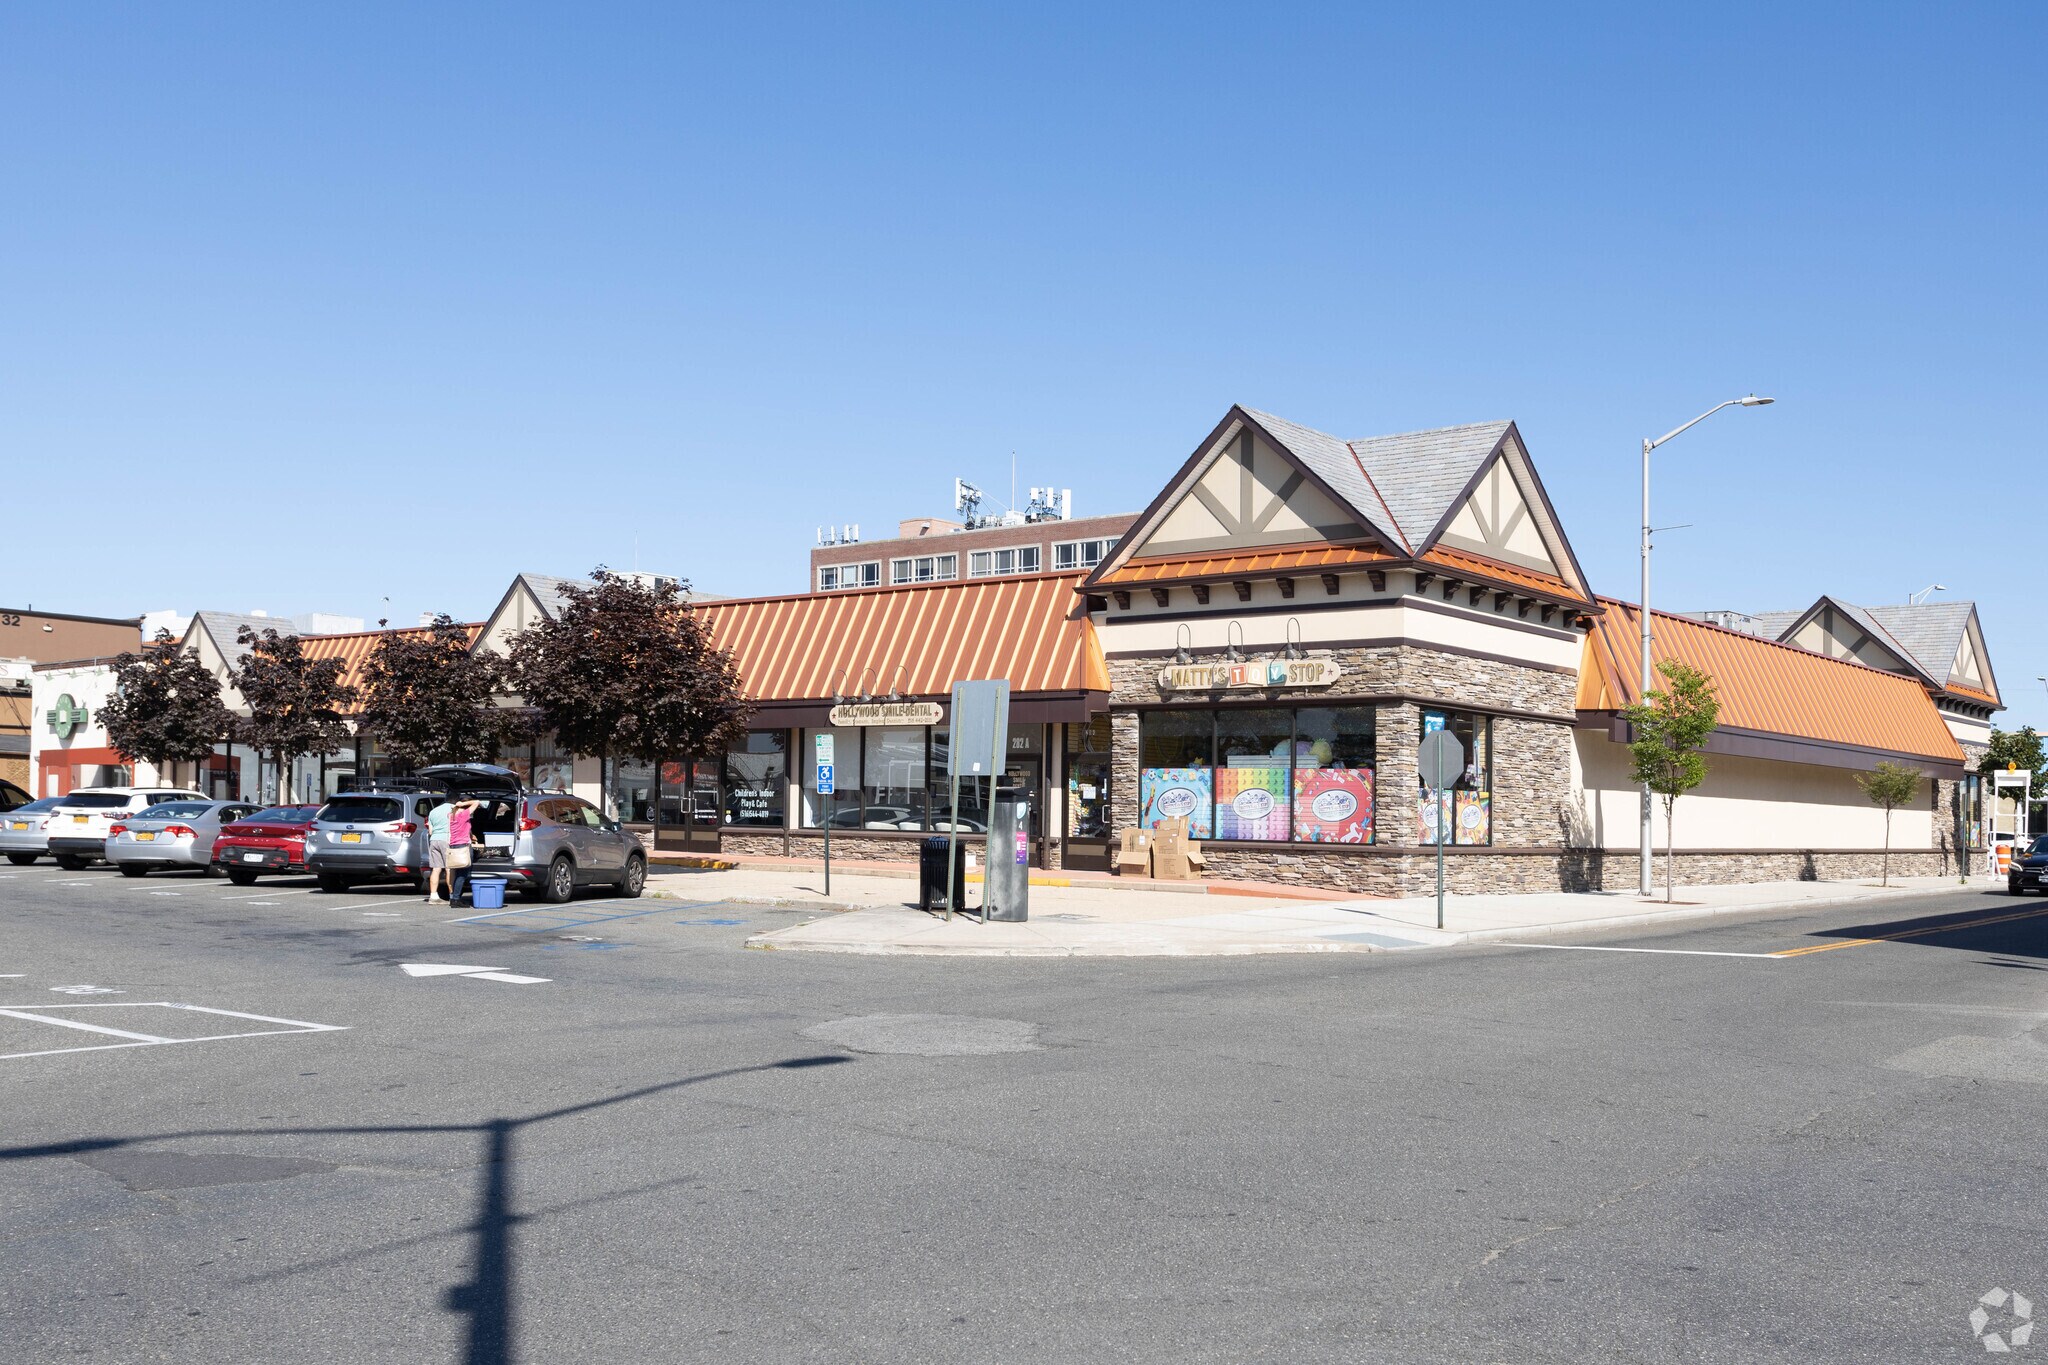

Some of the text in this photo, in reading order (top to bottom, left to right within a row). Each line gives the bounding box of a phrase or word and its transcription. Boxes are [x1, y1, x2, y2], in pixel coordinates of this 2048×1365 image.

[2, 614, 21, 627] 32
[1171, 662, 1325, 687] MATTY'S TOY STOP
[838, 703, 933, 719] HOLLYWOOD SMILE DENTAL
[735, 788, 775, 798] Children's Indoor
[756, 799, 768, 808] Cafe
